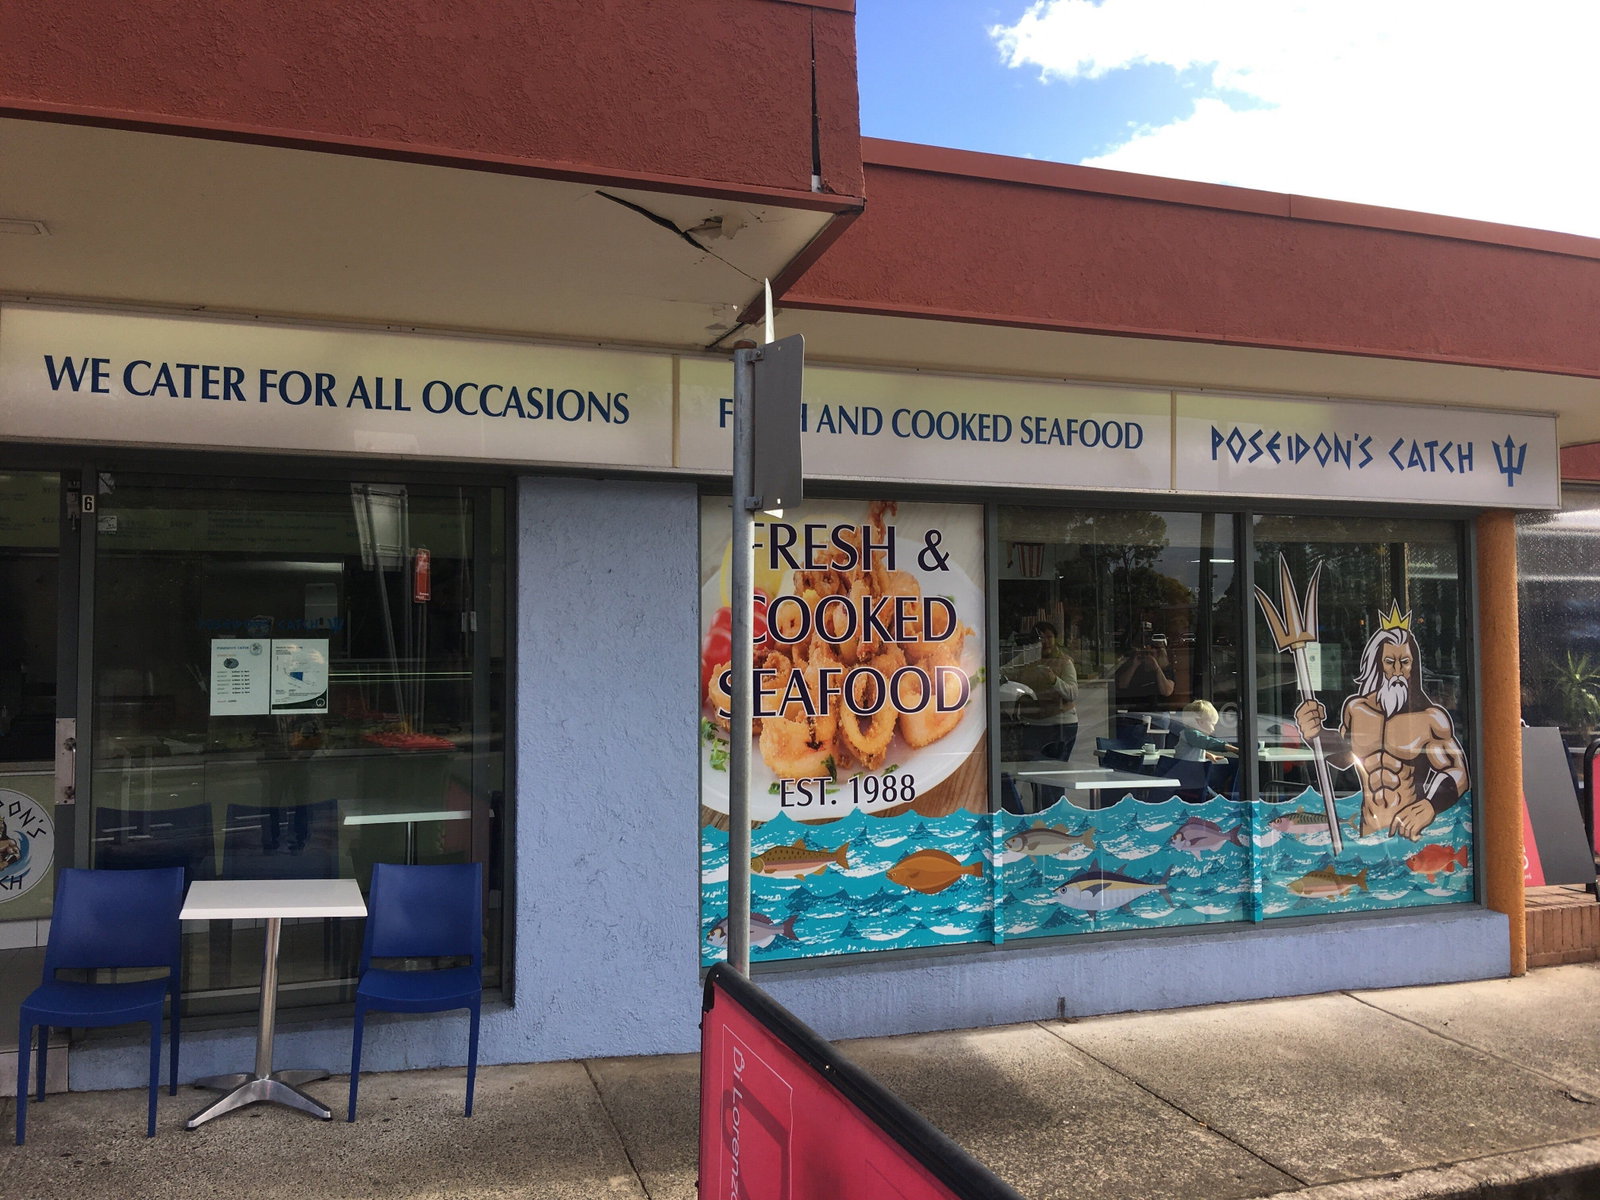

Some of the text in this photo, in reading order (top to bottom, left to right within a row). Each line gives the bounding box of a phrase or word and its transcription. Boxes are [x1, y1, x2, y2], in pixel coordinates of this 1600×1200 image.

[43, 355, 630, 425] WE CATER FOR ALL OCCASIONS
[816, 404, 884, 436] AND
[891, 408, 1013, 443] COOKED
[1020, 415, 1144, 450] SEAFOOD
[1211, 425, 1473, 474] POSEIDON'S CATCH
[84, 496, 93, 511] 6
[917, 529, 950, 572] &
[717, 666, 972, 719] SEAFOOD
[780, 774, 916, 807] EST. 1988
